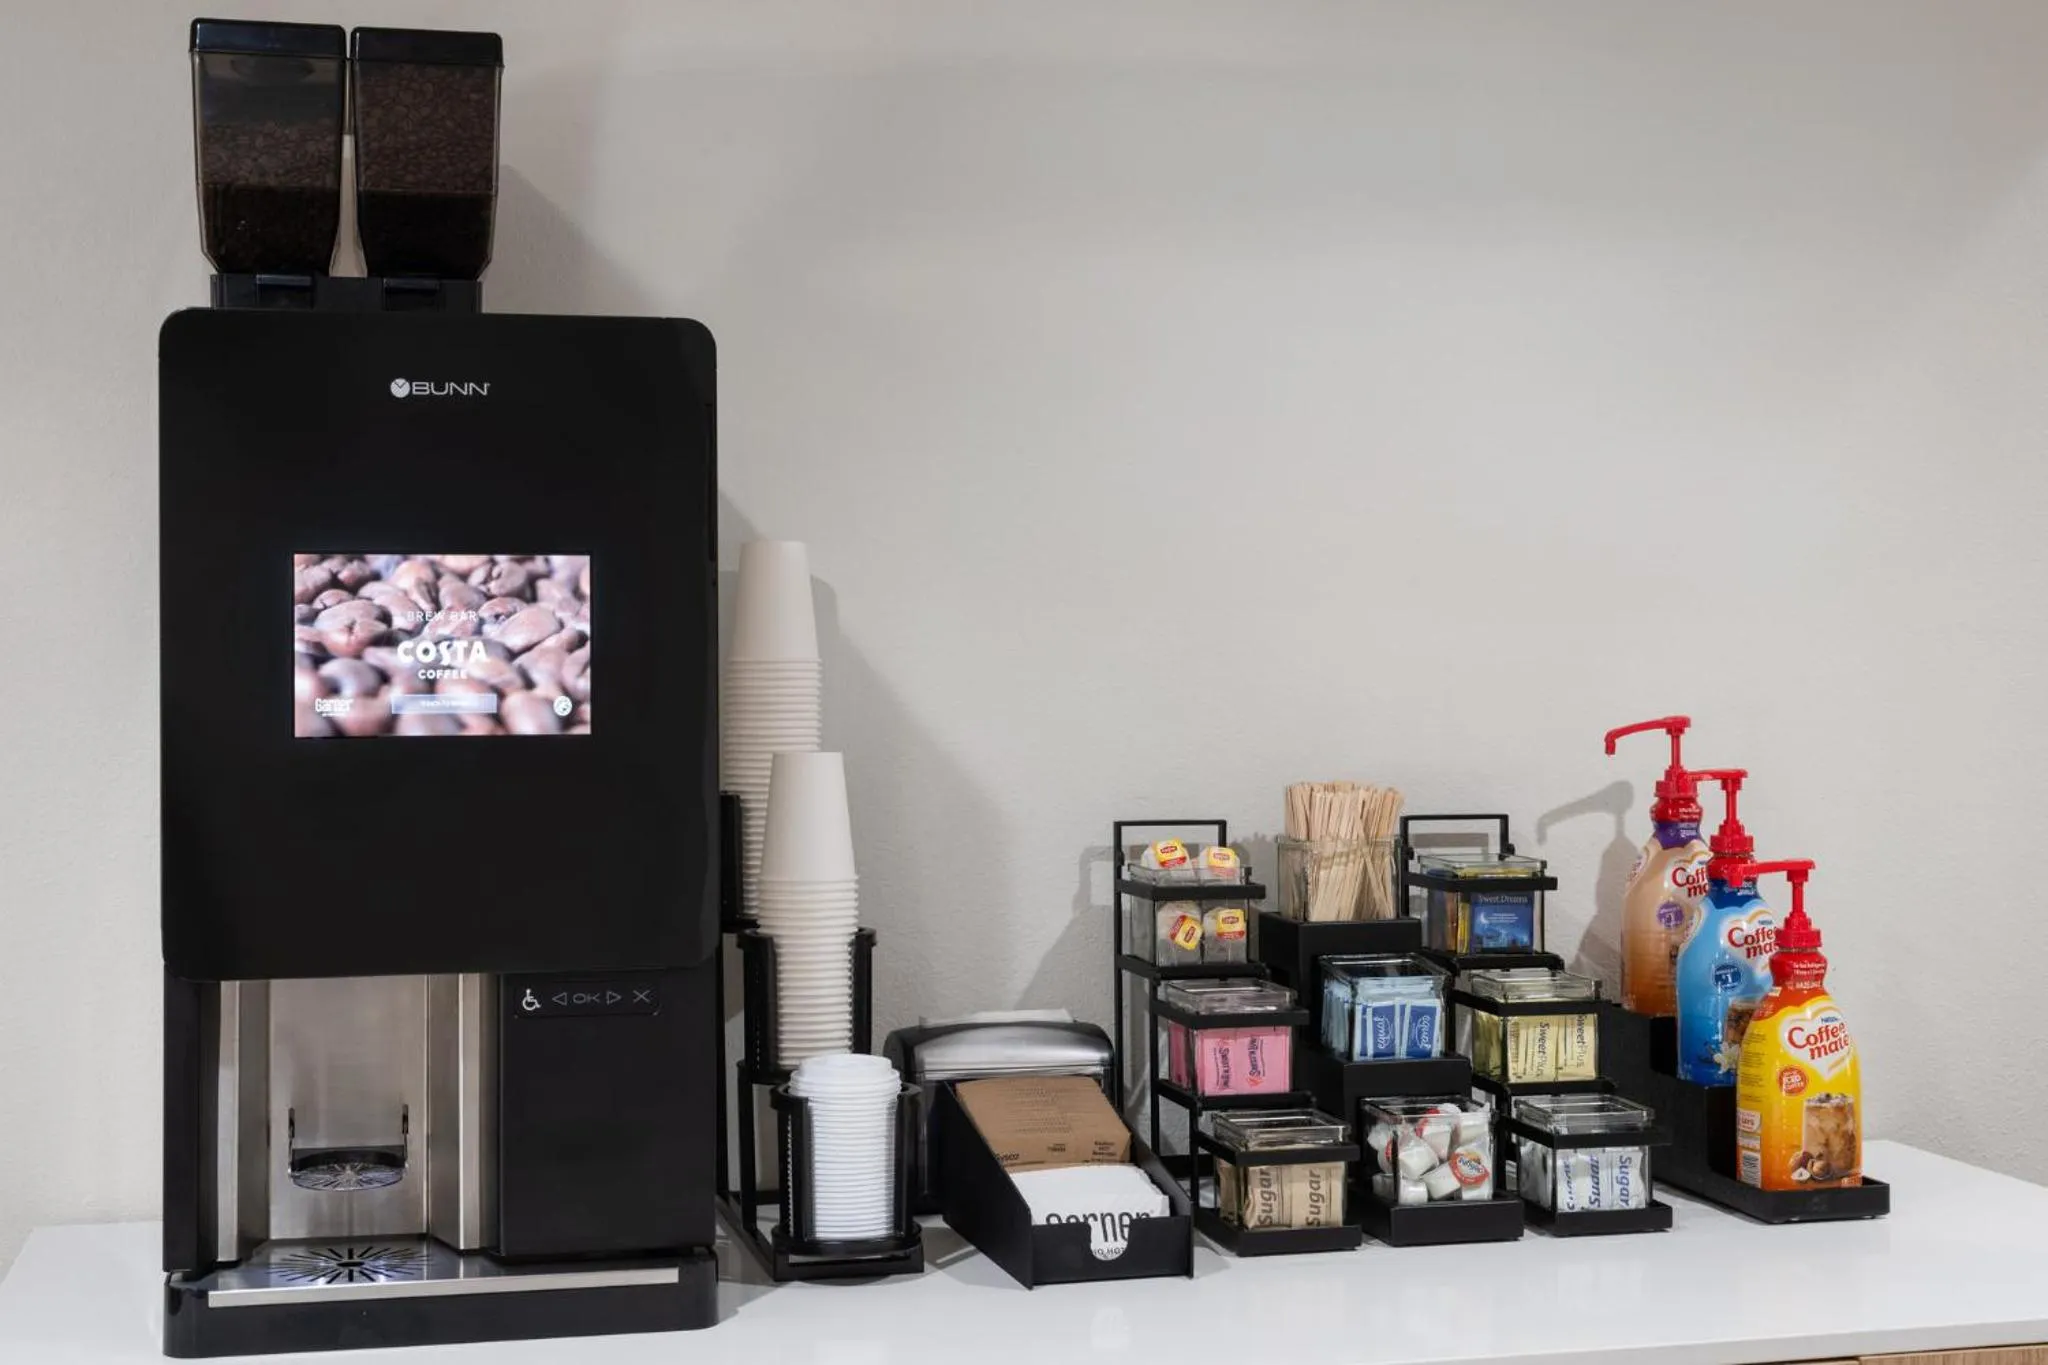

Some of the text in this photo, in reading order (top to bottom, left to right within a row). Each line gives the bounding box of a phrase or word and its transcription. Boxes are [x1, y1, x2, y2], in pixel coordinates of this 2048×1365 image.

[397, 640, 491, 666] COSTA
[418, 669, 468, 680] COFFEE
[1787, 1023, 1846, 1050] Coffee
[1256, 1167, 1277, 1226] Sugar
[1305, 1169, 1325, 1227] Sugar
[1616, 1155, 1632, 1207] Sugar
